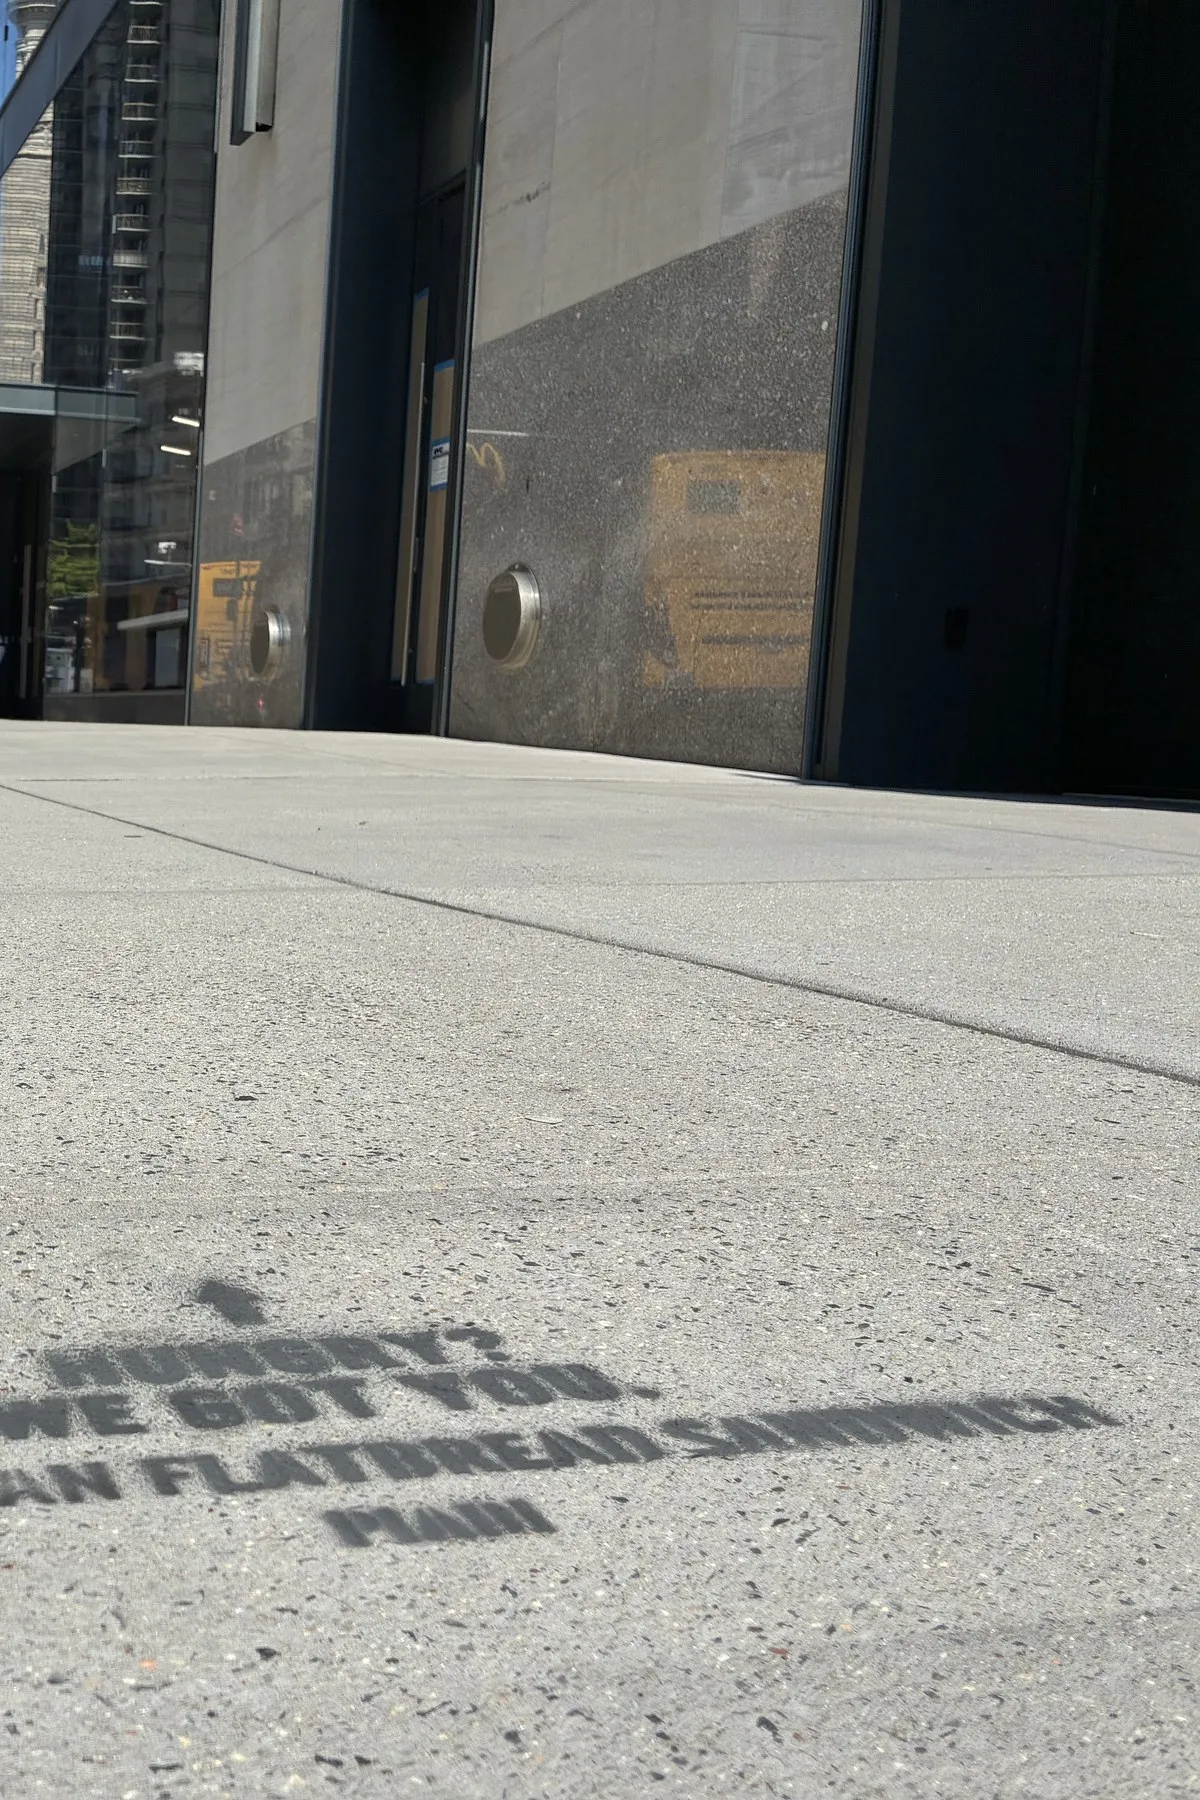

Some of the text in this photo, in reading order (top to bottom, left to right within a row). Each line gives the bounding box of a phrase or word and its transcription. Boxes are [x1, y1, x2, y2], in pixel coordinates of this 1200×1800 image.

[46, 1326, 512, 1387] HUNGRY?
[167, 1377, 377, 1430] GOT
[401, 1363, 662, 1411] YOU.
[142, 1424, 664, 1495] FLATBREAD
[659, 1396, 1124, 1460] SANDWICH
